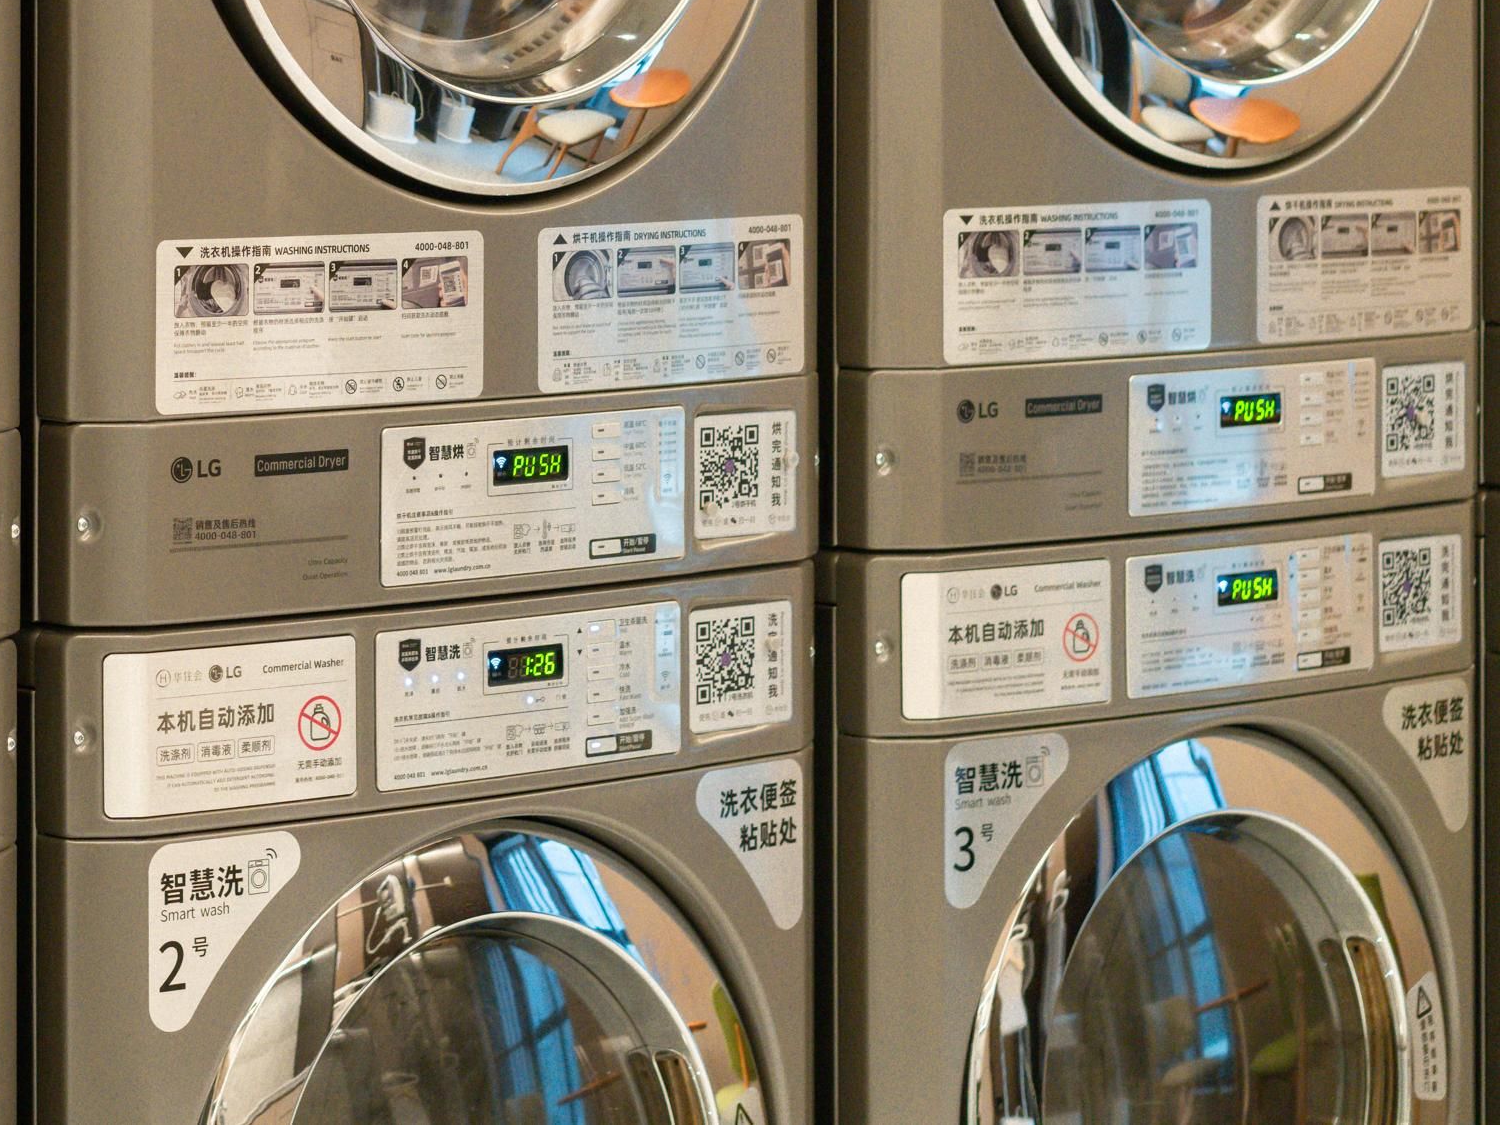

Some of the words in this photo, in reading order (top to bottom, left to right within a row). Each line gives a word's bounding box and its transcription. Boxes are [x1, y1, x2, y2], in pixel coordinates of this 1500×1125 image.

[572, 230, 631, 244] 烘干机操作指南
[634, 231, 659, 241] DRYING
[660, 228, 706, 239] INSTRUCTIONS
[200, 245, 272, 259] 洗衣机操作指南
[274, 245, 313, 256] WASHING
[314, 244, 370, 254] INSTRUCTIONS
[414, 241, 469, 251] 4000-048-801
[255, 265, 261, 275] 2
[330, 263, 336, 272] 3
[978, 402, 999, 418] LG
[1234, 398, 1276, 422] PUSH
[429, 444, 465, 462] 智慧烘
[197, 459, 222, 478] LG
[257, 457, 316, 472] Commercial
[318, 455, 346, 468] Dryer
[513, 453, 561, 477] PUSH
[771, 421, 782, 507] 烘完通知我
[1004, 585, 1018, 597] LG
[1232, 577, 1273, 600] PUSH
[948, 618, 1045, 645] 本机自动添加
[425, 644, 460, 662] 智慧洗
[225, 665, 242, 679] LG
[262, 661, 312, 674] Commercial
[313, 658, 345, 669] Washer
[525, 652, 555, 677] 1:26
[156, 703, 275, 734] 本机自动添加
[1401, 697, 1464, 730] 洗衣便签
[200, 743, 232, 758] 消毒液
[241, 739, 272, 754] 柔顺剂
[1417, 729, 1464, 761] 粘贴处
[159, 748, 192, 763] 洗涤剂
[954, 760, 1023, 795] 智慧洗
[720, 779, 797, 819] 洗衣便签
[954, 797, 984, 811] Smart
[987, 793, 1012, 806] wash
[739, 816, 797, 852] 粘贴处
[953, 826, 975, 872] 3
[980, 823, 994, 843] 号
[160, 864, 244, 906] 智慧洗
[160, 907, 196, 923] Smart
[200, 902, 230, 918] wash
[159, 940, 187, 993] 2
[192, 936, 209, 958] 号
